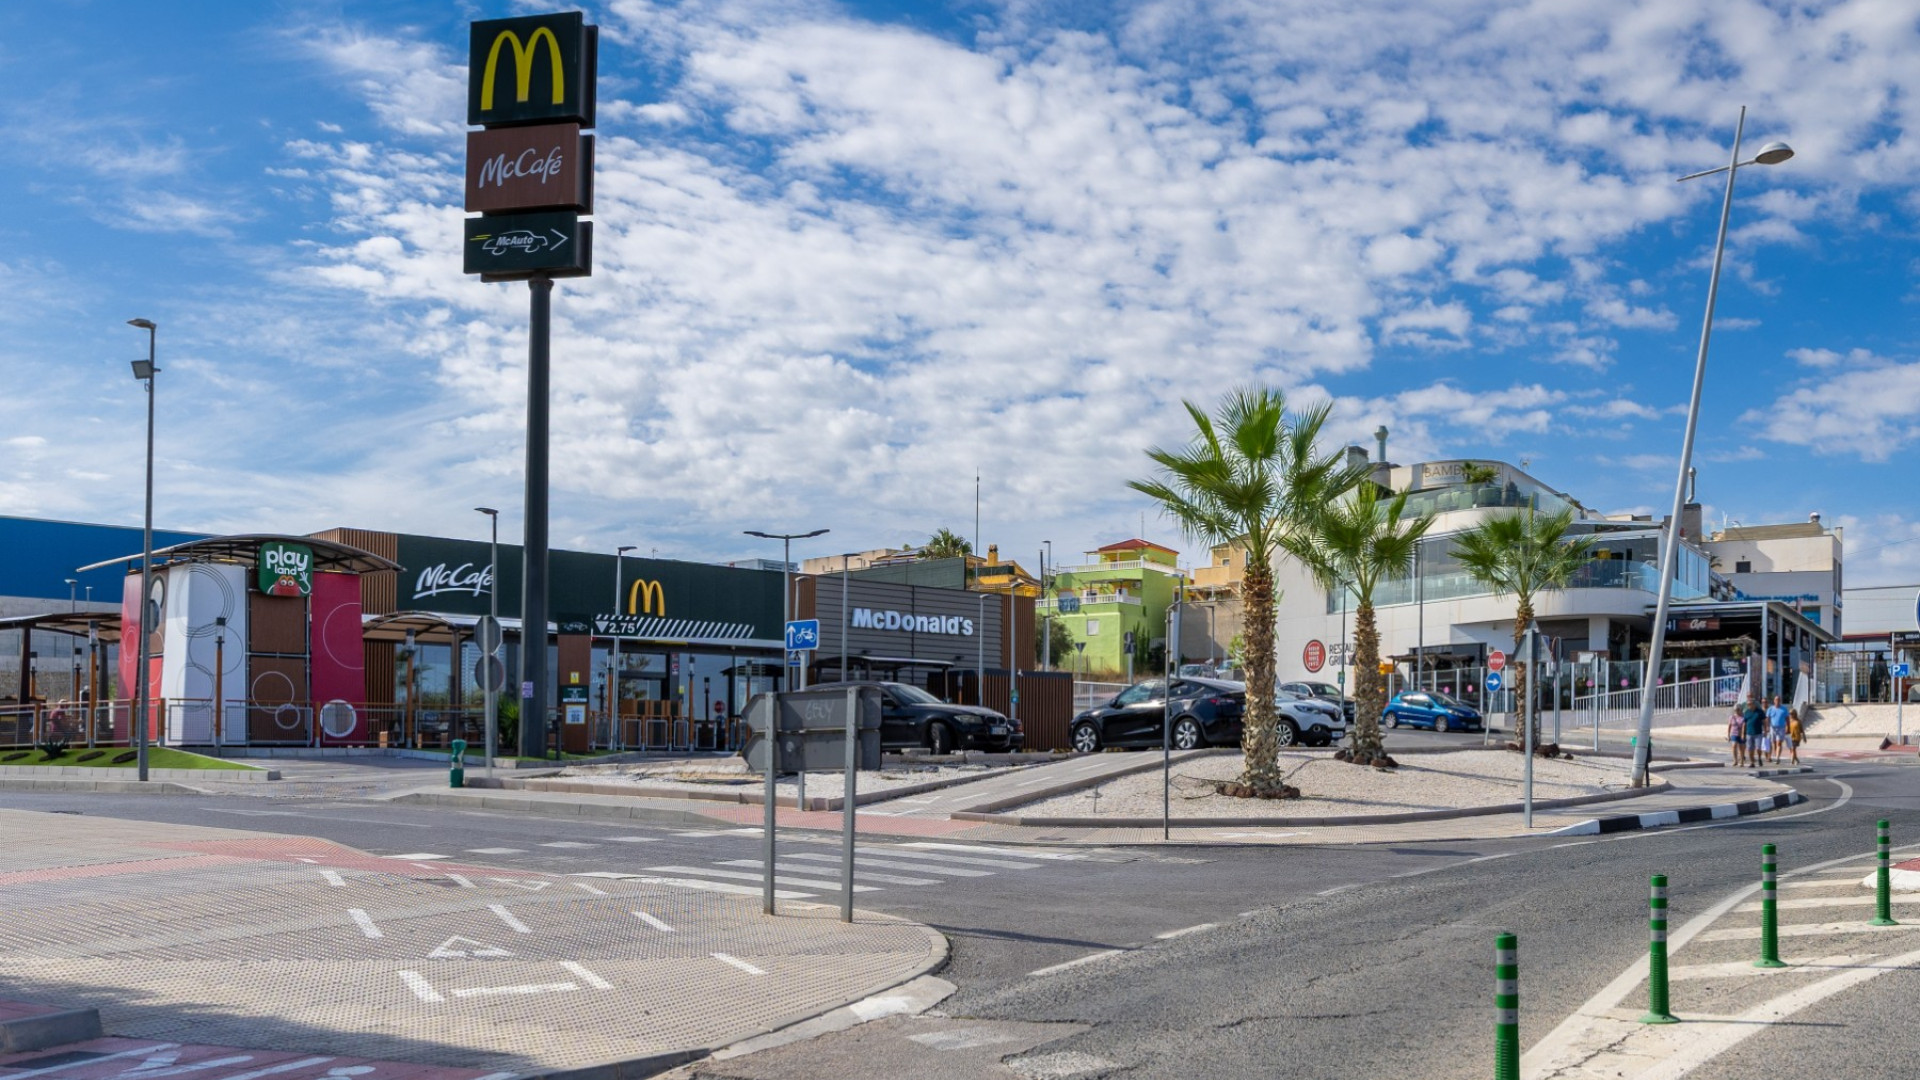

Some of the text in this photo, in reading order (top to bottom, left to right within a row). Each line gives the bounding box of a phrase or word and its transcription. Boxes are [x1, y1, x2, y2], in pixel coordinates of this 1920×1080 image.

[478, 146, 563, 188] McCafé
[496, 236, 534, 246] McAuto
[265, 545, 309, 571] play
[274, 564, 297, 575] land
[852, 607, 974, 635] McDonald's
[608, 622, 636, 634] 2.75
[1892, 665, 1901, 676] P
